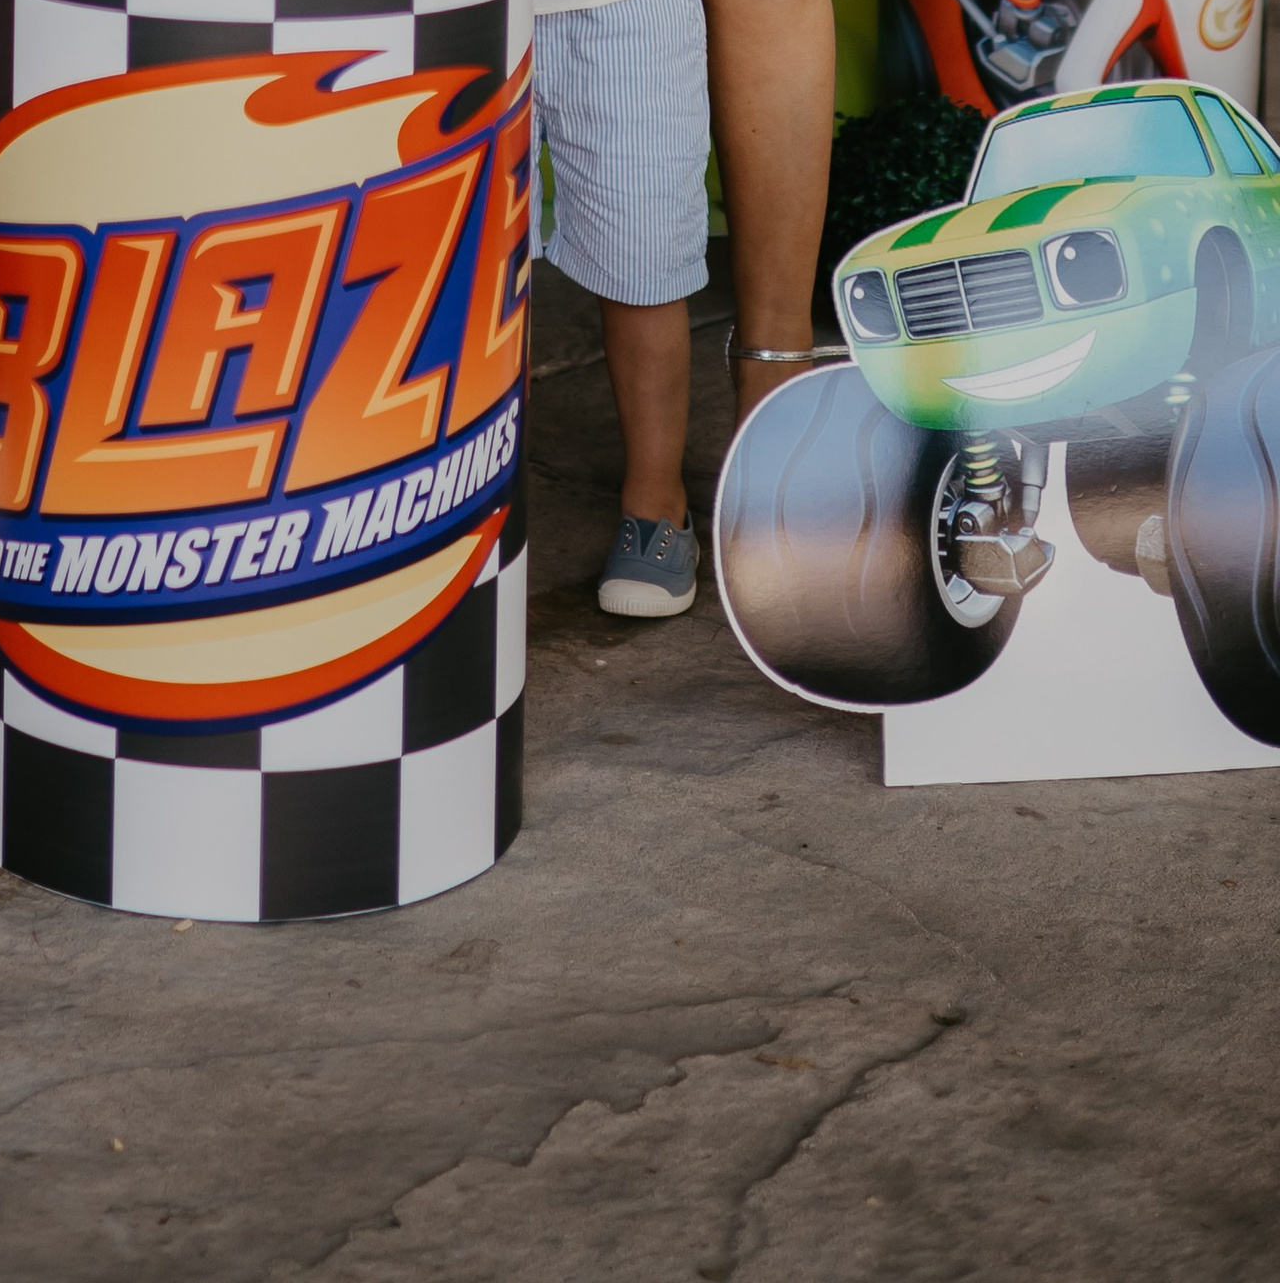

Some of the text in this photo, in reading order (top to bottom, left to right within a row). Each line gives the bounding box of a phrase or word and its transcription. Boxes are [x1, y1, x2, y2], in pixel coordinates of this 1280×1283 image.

[3, 540, 52, 582] THE
[51, 510, 309, 595] MONSTER
[312, 397, 519, 563] MACHINES
